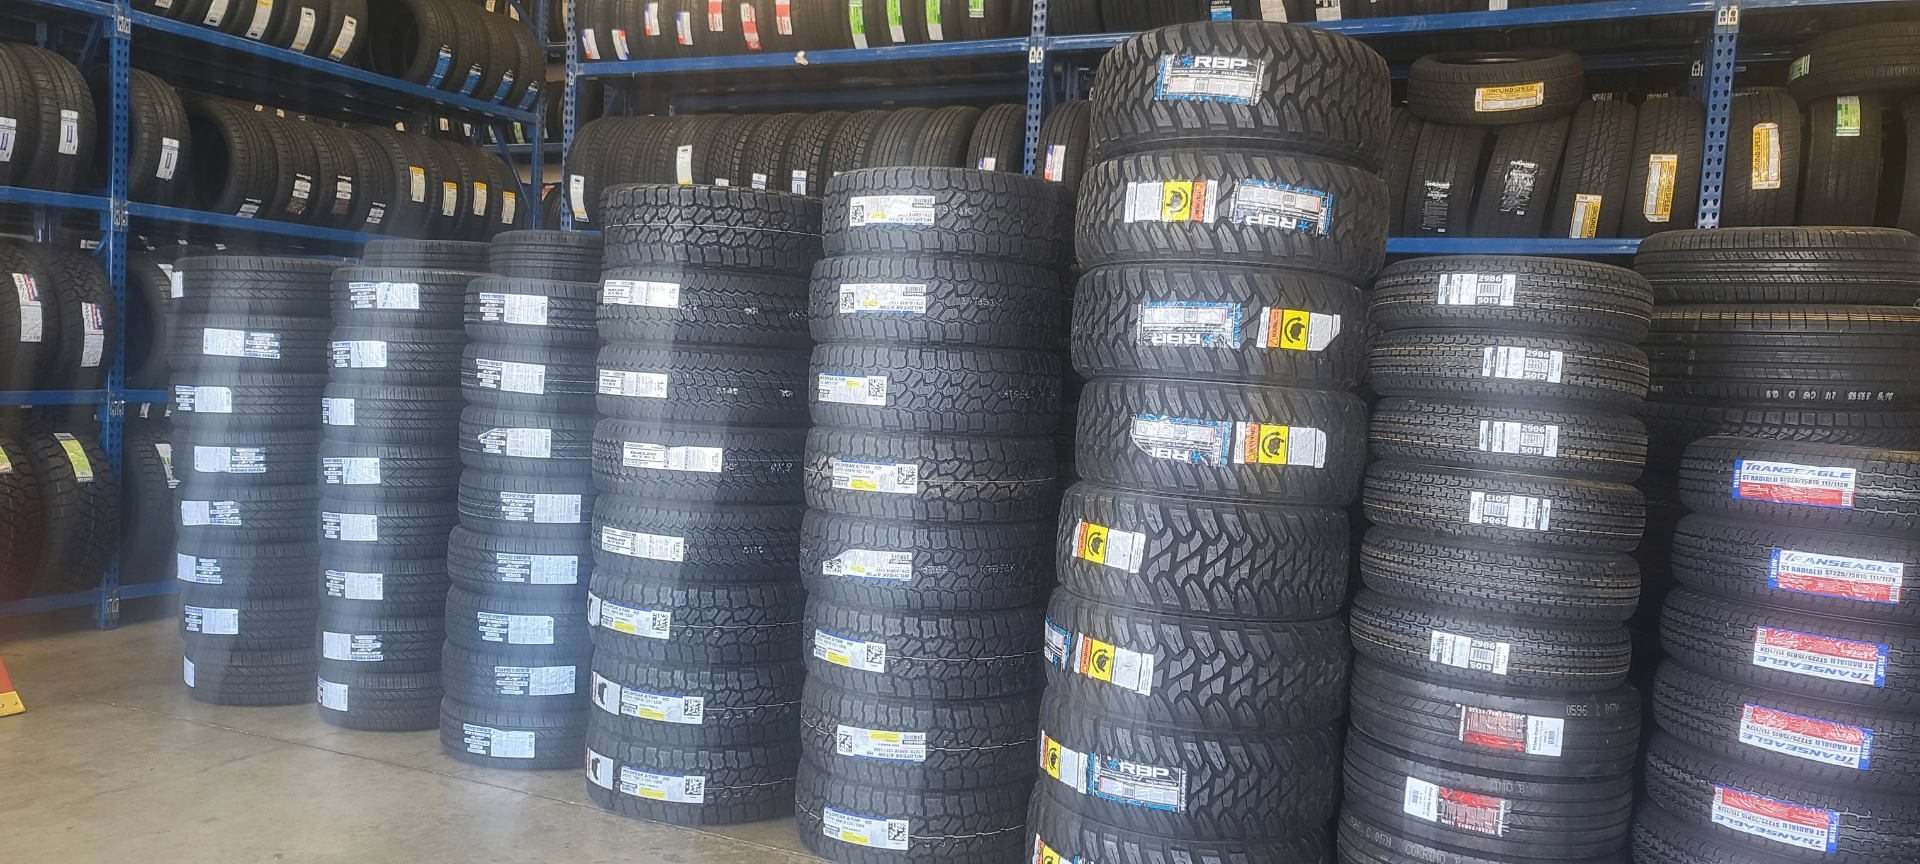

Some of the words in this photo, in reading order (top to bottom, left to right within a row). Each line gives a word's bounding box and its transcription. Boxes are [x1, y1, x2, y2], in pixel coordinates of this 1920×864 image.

[1194, 56, 1248, 69] RBP
[1246, 214, 1297, 230] RBP
[1478, 274, 1501, 283] 2986
[1151, 333, 1201, 346] RBP
[1526, 350, 1550, 359] 2986
[1524, 372, 1547, 381] 5013
[1521, 424, 1545, 433] 2986
[1520, 446, 1543, 455] 5013
[1746, 462, 1853, 479] TRANSEAGLE
[1780, 476, 1820, 486] ST225/75R15
[1822, 480, 1849, 488] 117/112N
[1486, 494, 1508, 503] 5013
[1482, 516, 1507, 525] 2986
[1781, 564, 1789, 572] ST
[1825, 568, 1868, 580] ST225/75R15
[1870, 574, 1897, 583] 117/112N
[1471, 640, 1496, 650] 2986
[1470, 661, 1492, 672] 5013
[1756, 654, 1871, 682] TRANSEAGLE
[1864, 662, 1874, 670] ST
[1566, 704, 1589, 717] 0596
[1742, 732, 1855, 766] TRANSEAGLE
[1848, 744, 1859, 753] ST
[1119, 760, 1170, 778] RBP
[1714, 814, 1822, 849] TRANSEAGLE
[1814, 828, 1826, 837] ST
